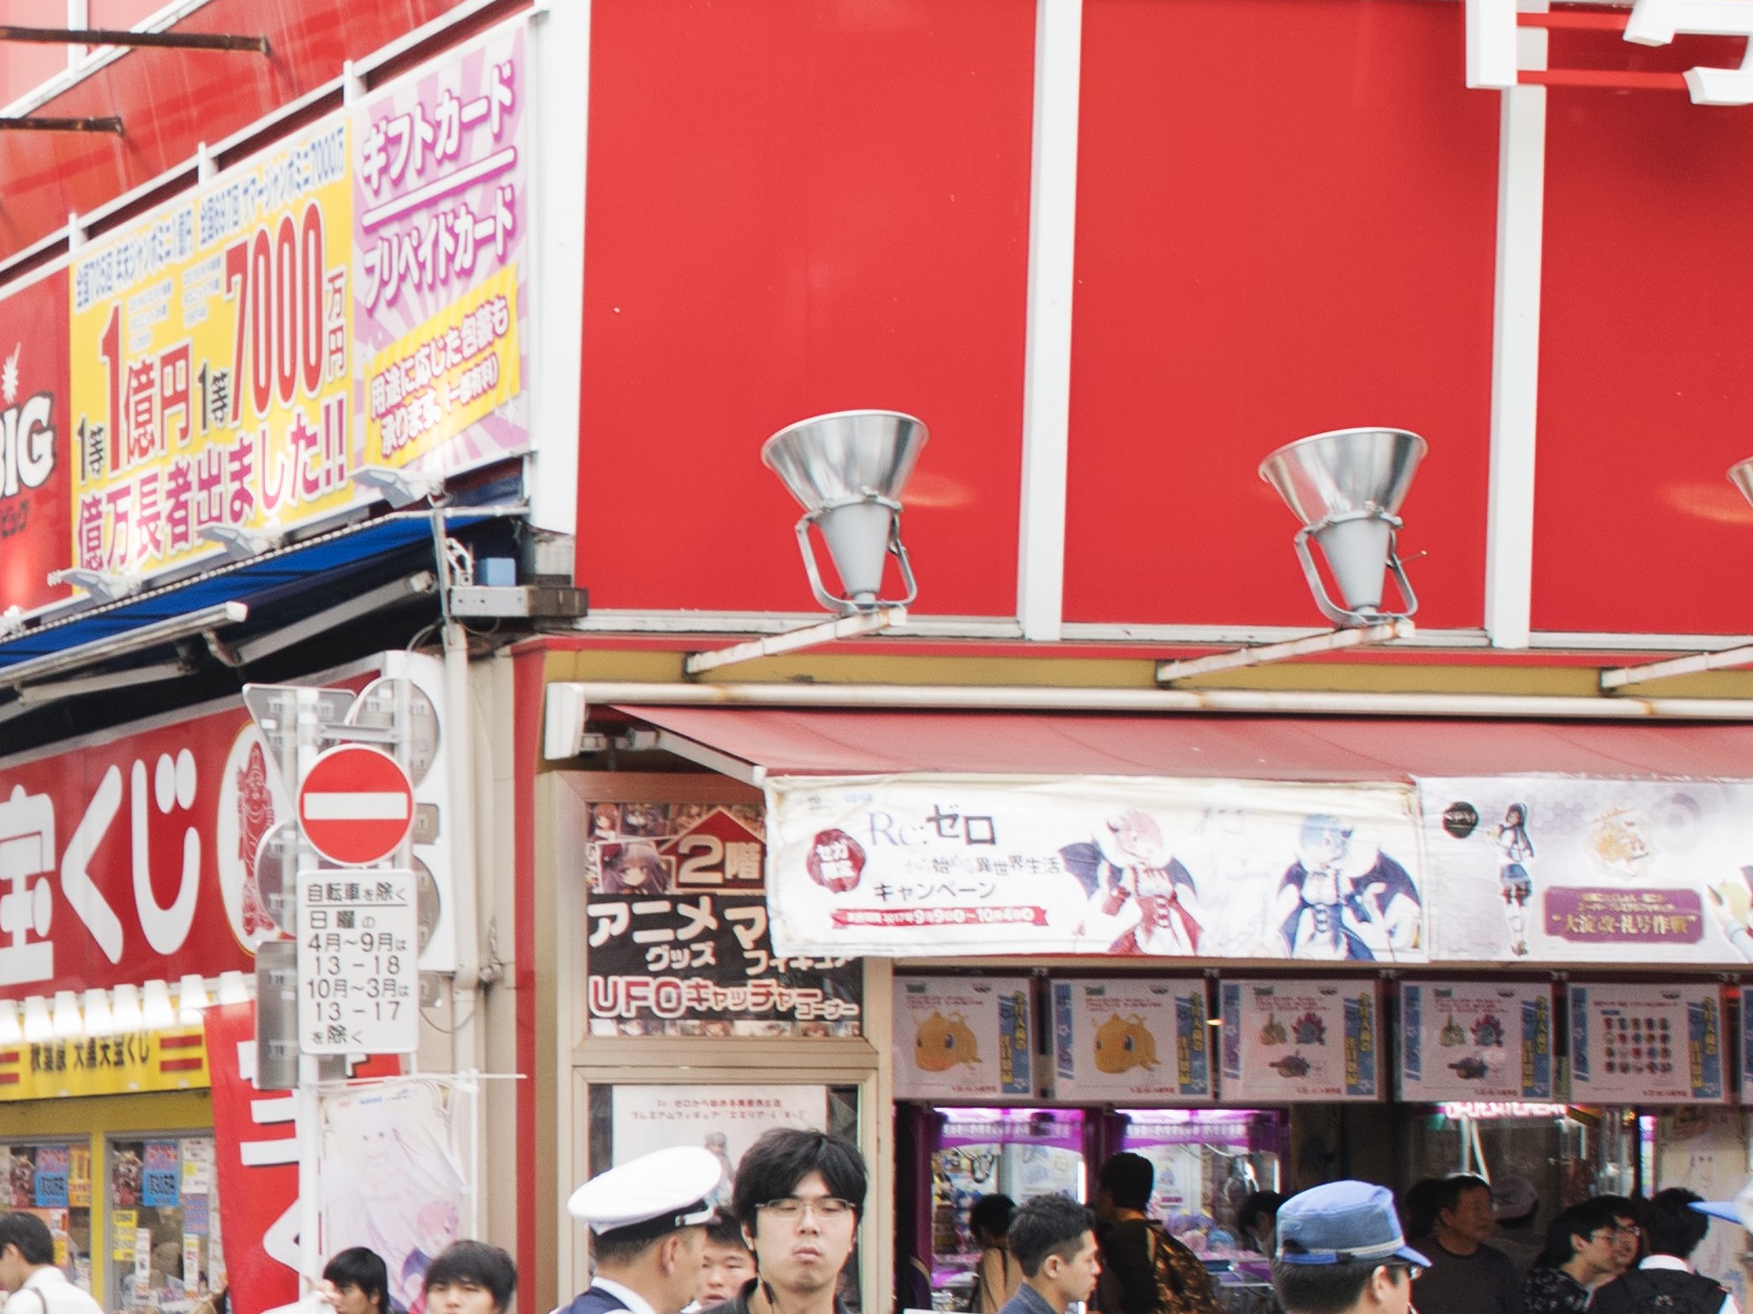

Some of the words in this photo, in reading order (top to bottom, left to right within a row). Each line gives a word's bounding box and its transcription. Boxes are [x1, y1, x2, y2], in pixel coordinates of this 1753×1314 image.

[362, 60, 514, 192] ギフトカード
[363, 184, 514, 315] プリペイドカード
[371, 294, 509, 421] 用途に応じた包装も
[676, 834, 761, 885] 2階
[307, 882, 407, 902] 自転車を除く
[587, 895, 718, 948] アニメ
[645, 941, 717, 973] グッズ
[588, 976, 823, 1019] UFOキャッチャー
[312, 1025, 363, 1045] を除く
